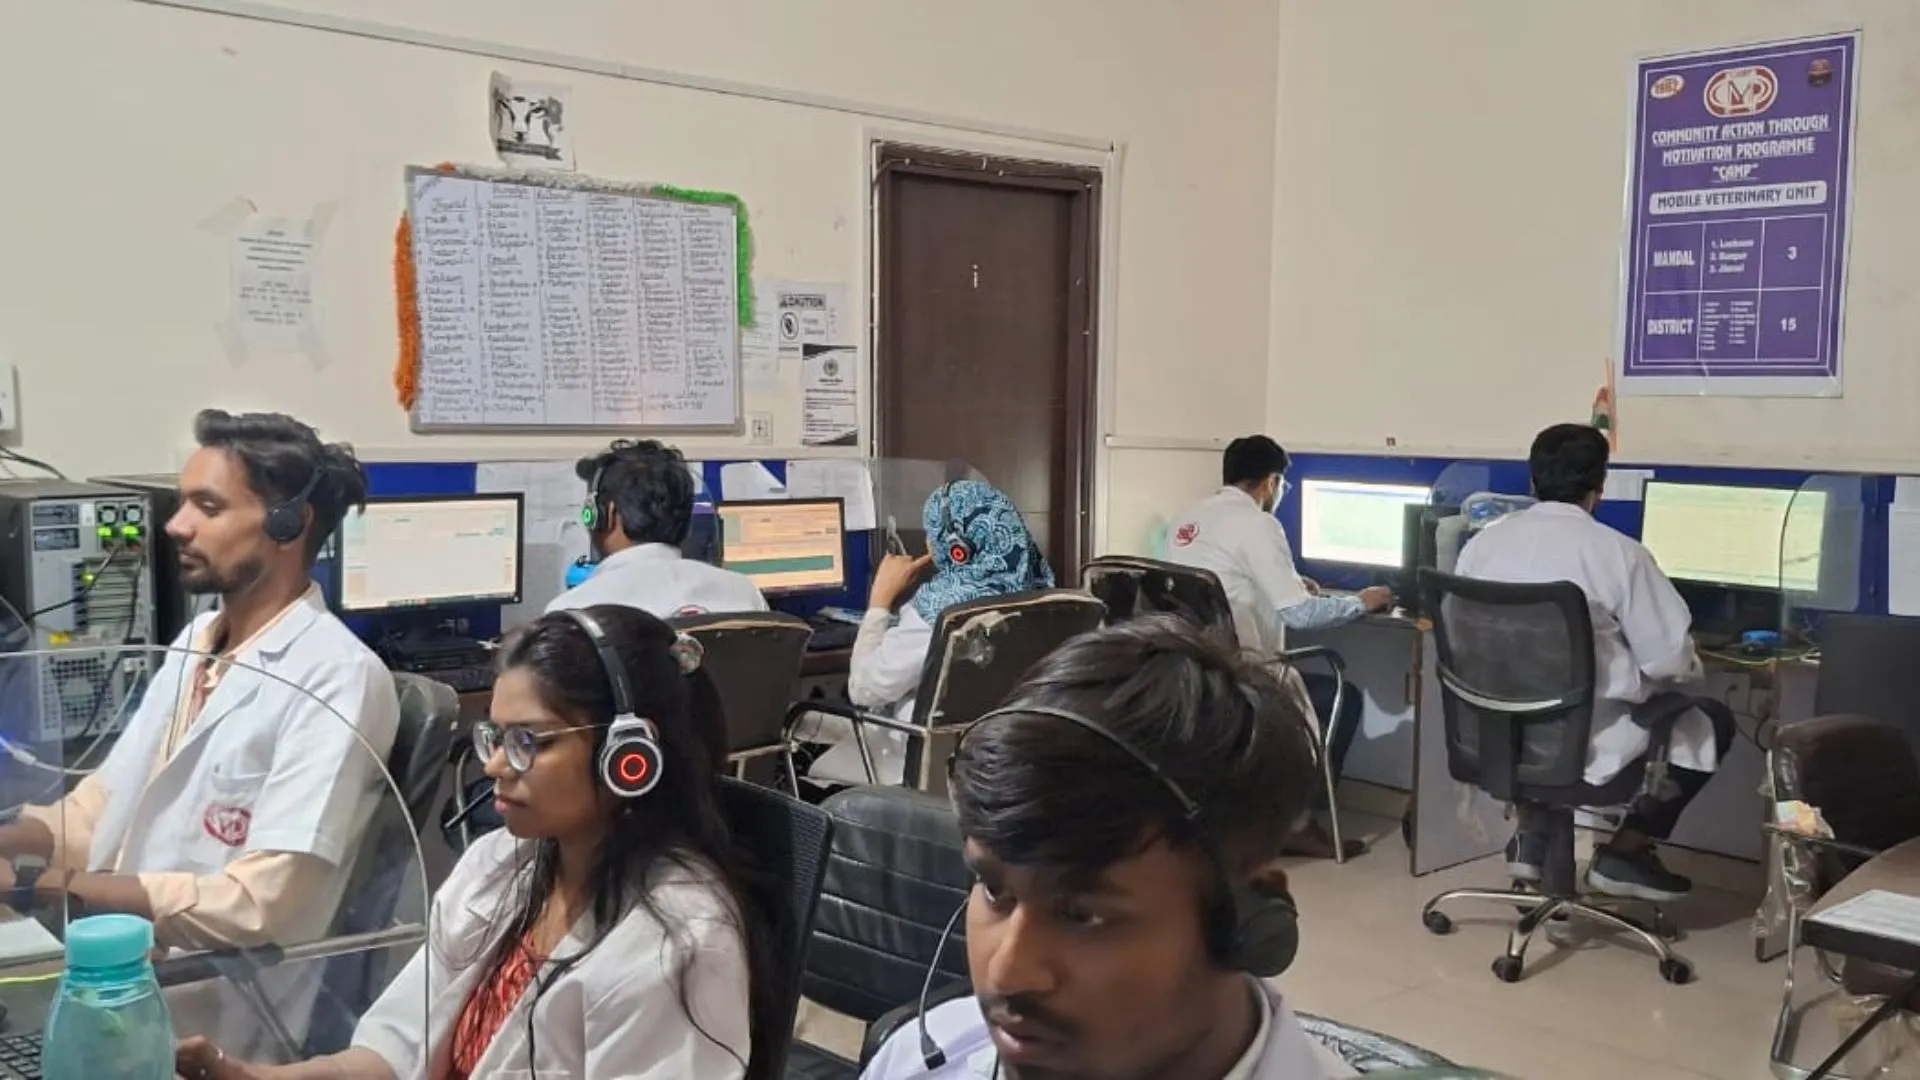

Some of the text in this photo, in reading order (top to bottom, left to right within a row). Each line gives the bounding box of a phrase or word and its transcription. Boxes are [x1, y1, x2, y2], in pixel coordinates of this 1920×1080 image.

[1652, 114, 1829, 145] COMMUNITY ACTION THROUGH
[1663, 137, 1815, 165] MOTIVATION PROGRAMME
[1658, 186, 1816, 208] MOBILE VETERINARY UNIT
[1653, 249, 1695, 266] MANDAL
[1787, 246, 1798, 260] 3
[1647, 318, 1694, 335] DISTRICT
[1781, 317, 1797, 332] 15
